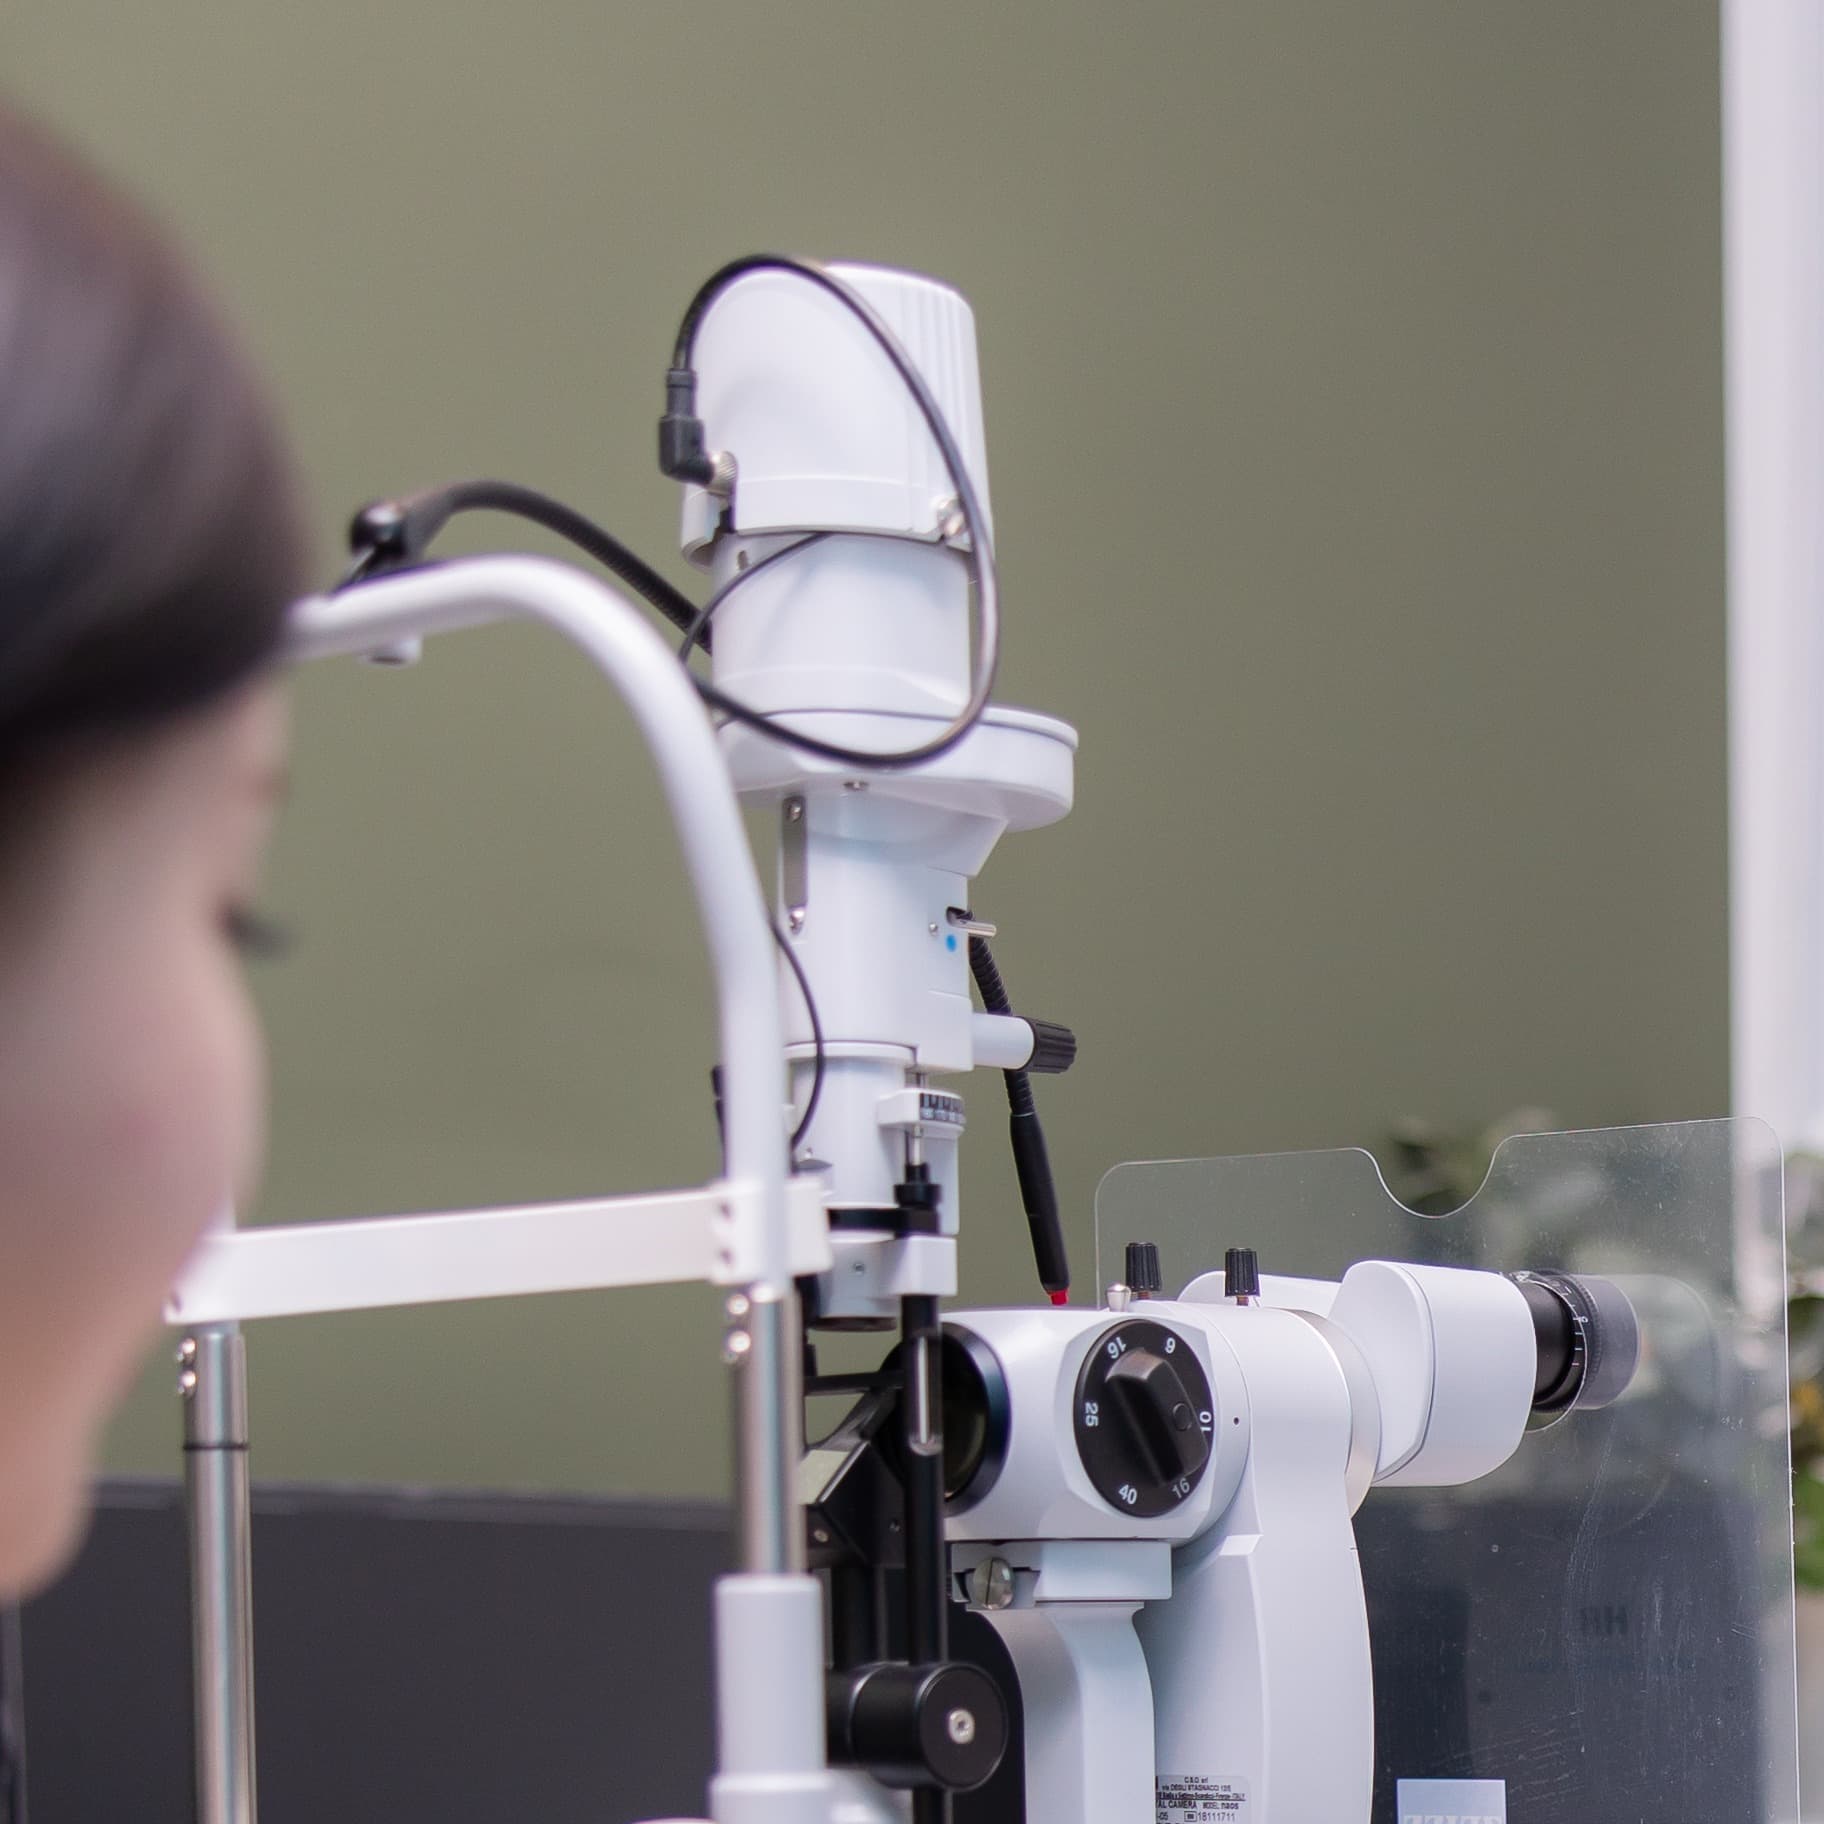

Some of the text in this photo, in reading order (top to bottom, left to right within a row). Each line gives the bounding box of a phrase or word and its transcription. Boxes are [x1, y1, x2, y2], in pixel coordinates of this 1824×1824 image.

[1106, 1336, 1128, 1360] 16
[1084, 1401, 1099, 1428] 25
[1199, 1410, 1212, 1433] 10
[1118, 1483, 1139, 1505] 40
[1172, 1477, 1191, 1499] 16
[1168, 1799, 1198, 1809] CAMERA
